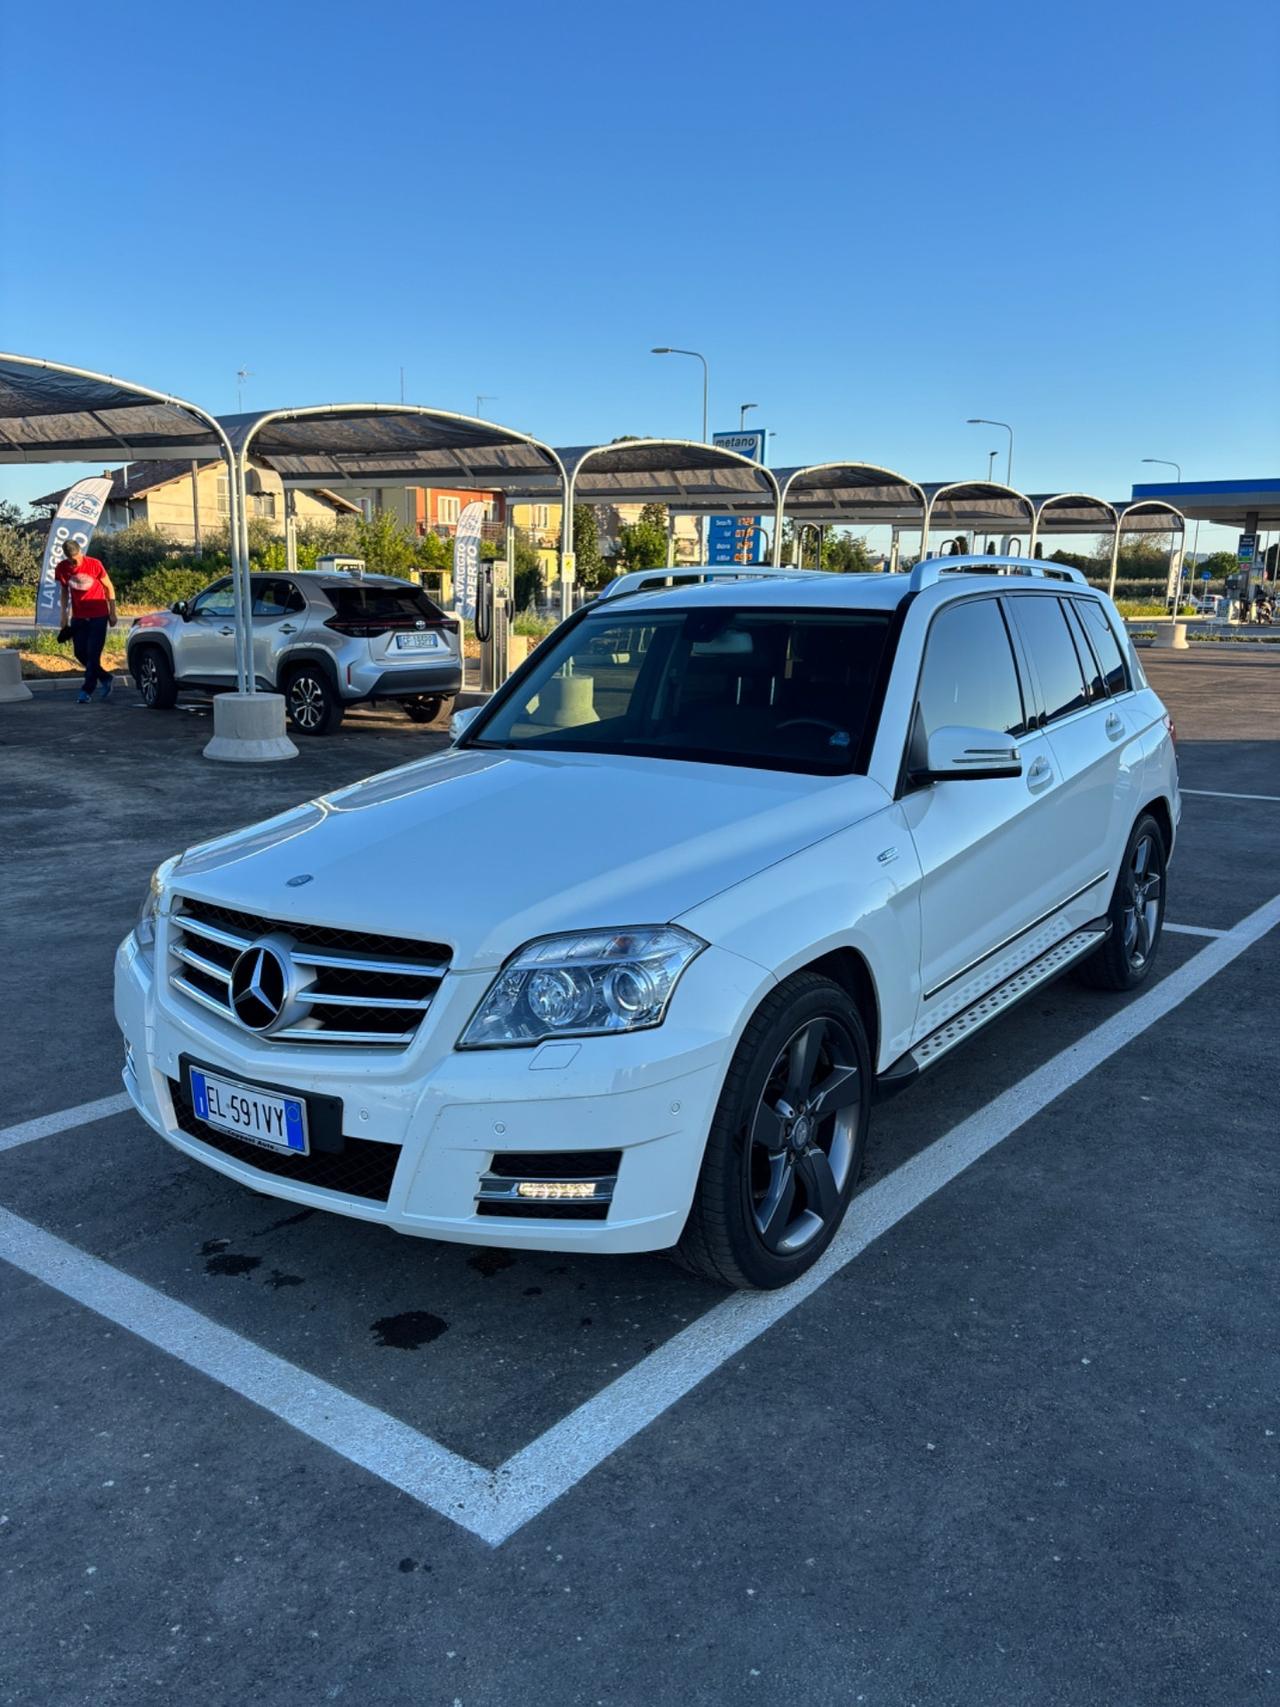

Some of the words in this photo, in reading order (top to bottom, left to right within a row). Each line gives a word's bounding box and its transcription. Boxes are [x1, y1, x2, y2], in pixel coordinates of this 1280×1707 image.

[716, 437, 754, 448] metano
[41, 526, 70, 609] LAVAGGIO
[456, 542, 466, 607] LAVAGGIO
[466, 545, 478, 607] APERTO
[206, 1086, 227, 1118] EL
[230, 1094, 283, 1137] 591VY
